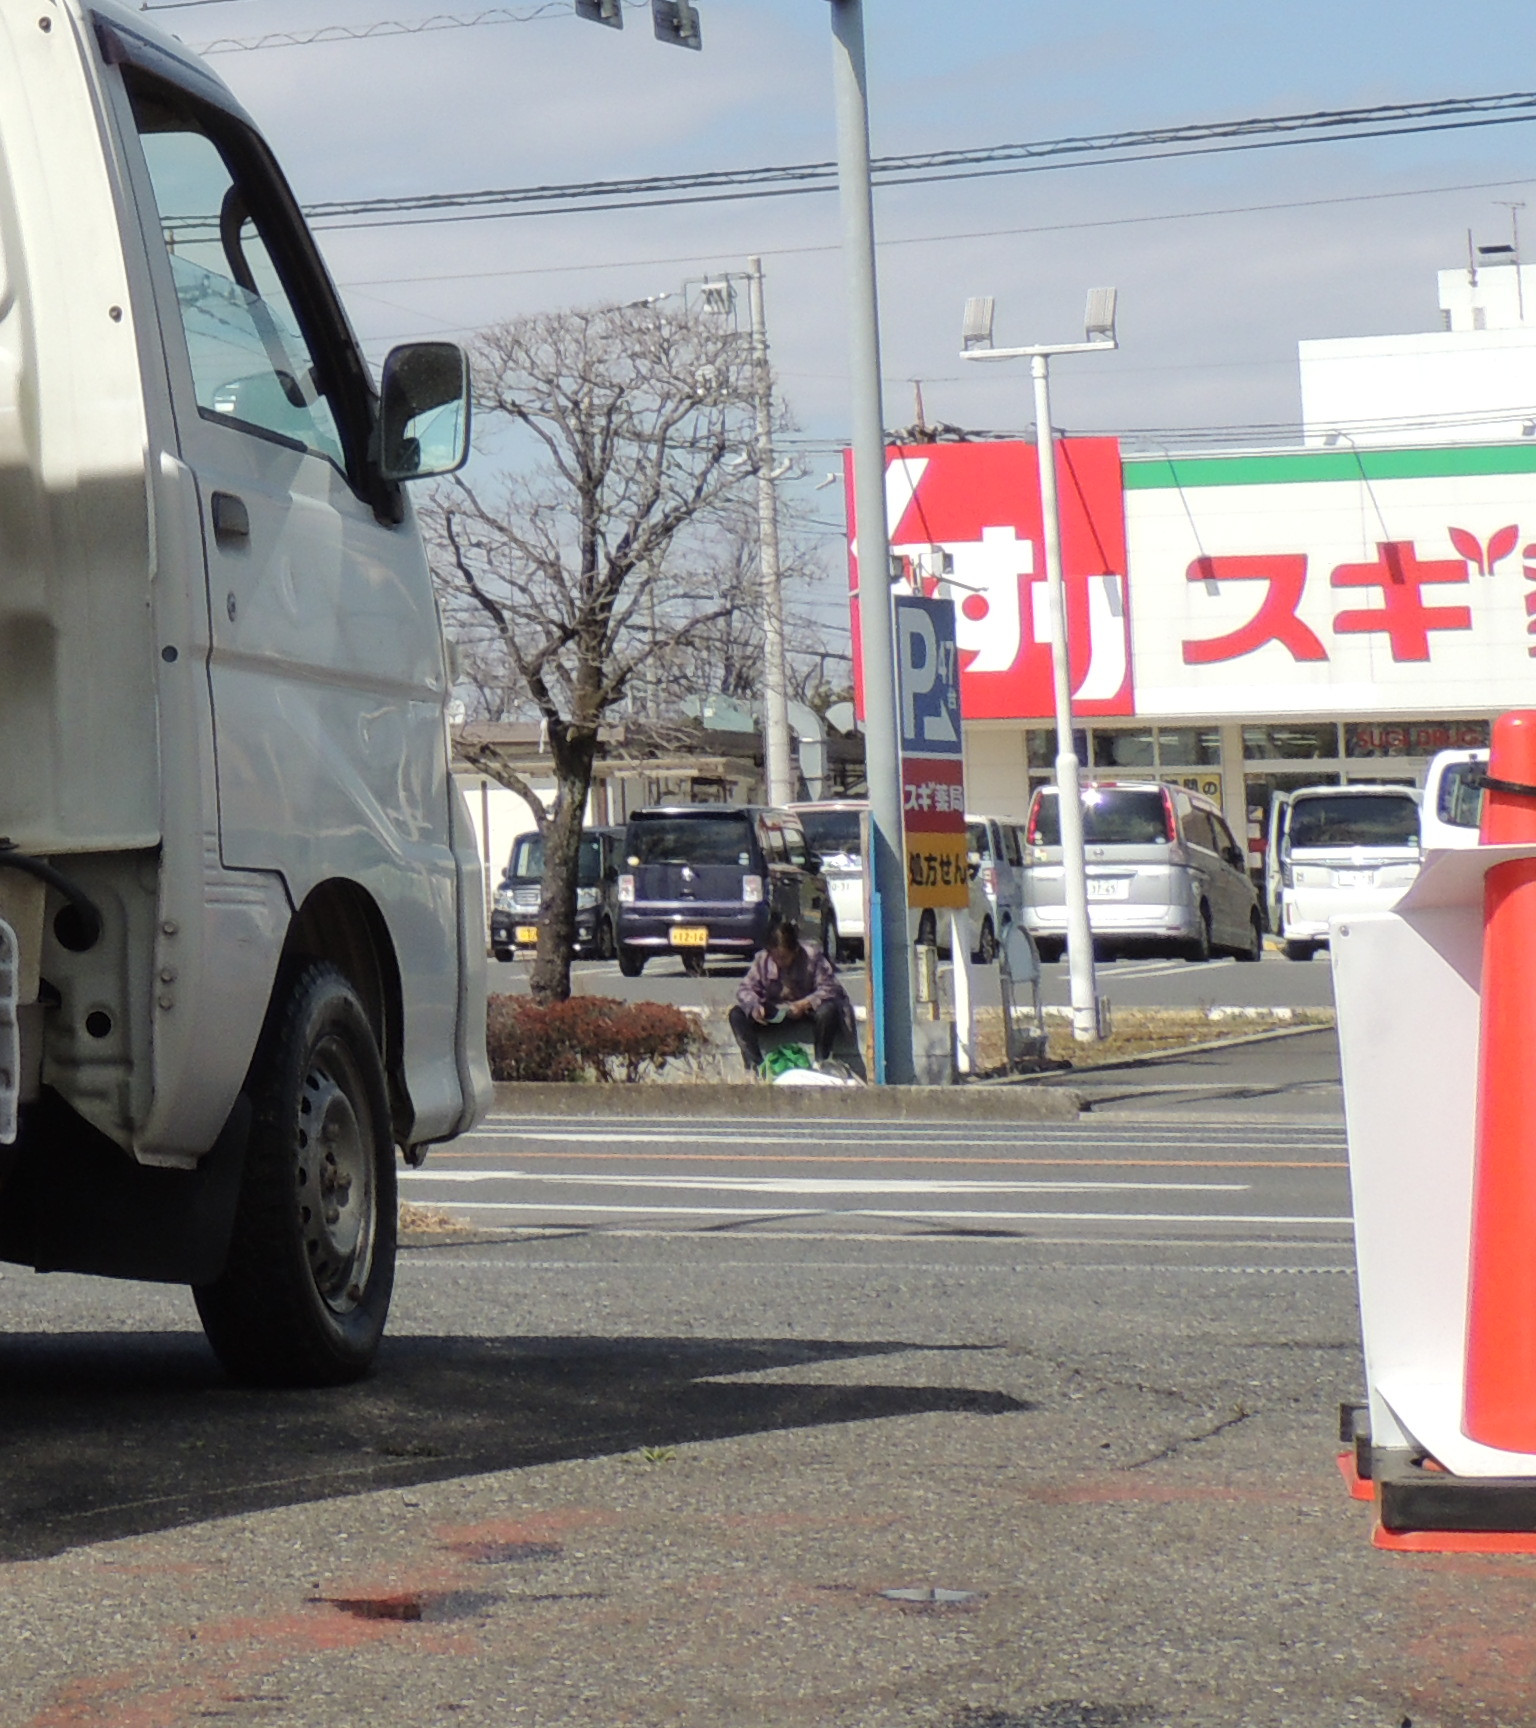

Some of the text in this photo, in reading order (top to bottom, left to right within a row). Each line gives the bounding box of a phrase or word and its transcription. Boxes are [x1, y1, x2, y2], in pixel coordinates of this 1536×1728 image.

[1182, 524, 1536, 665] スギ
[898, 606, 937, 739] P
[1357, 730, 1409, 748] SUGI
[904, 781, 964, 812] スギ薬局
